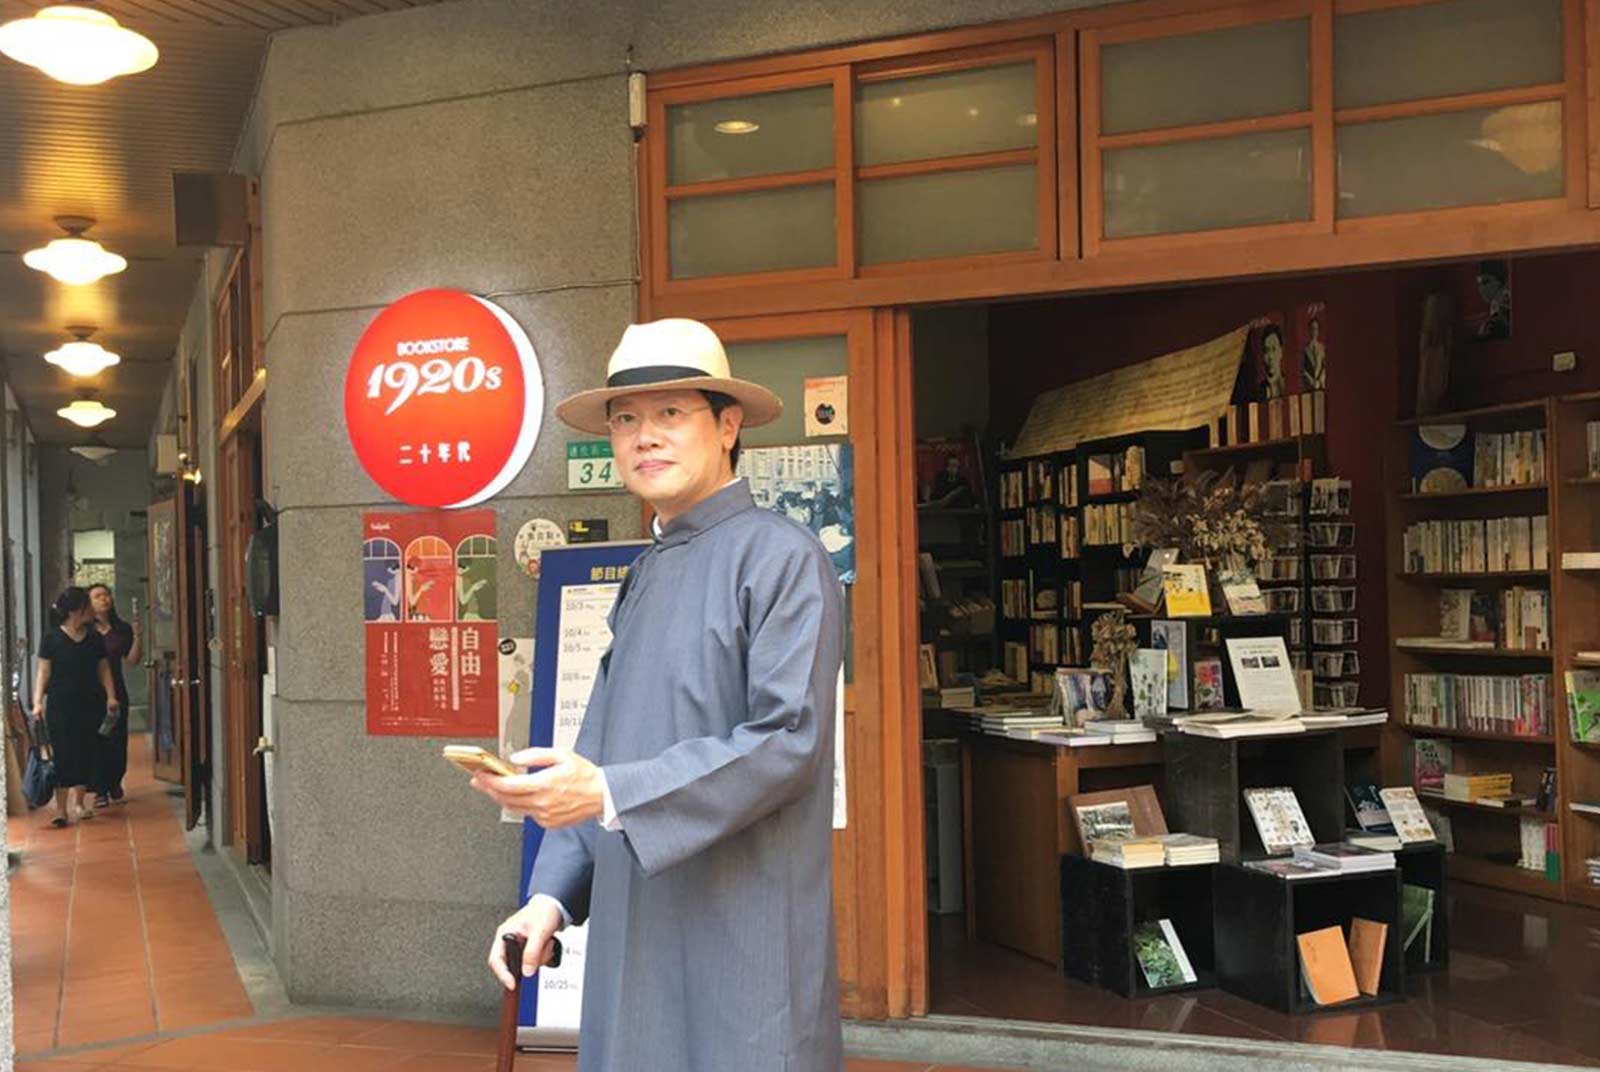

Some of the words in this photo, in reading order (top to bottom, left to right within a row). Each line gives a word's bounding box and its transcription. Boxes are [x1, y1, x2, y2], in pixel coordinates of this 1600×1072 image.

[396, 337, 470, 355] BOOKSTORE
[366, 356, 503, 416] 1920s
[398, 440, 472, 465] 二十年代
[580, 461, 612, 484] 34
[429, 627, 449, 676] 戀愛
[461, 626, 481, 676] 自由
